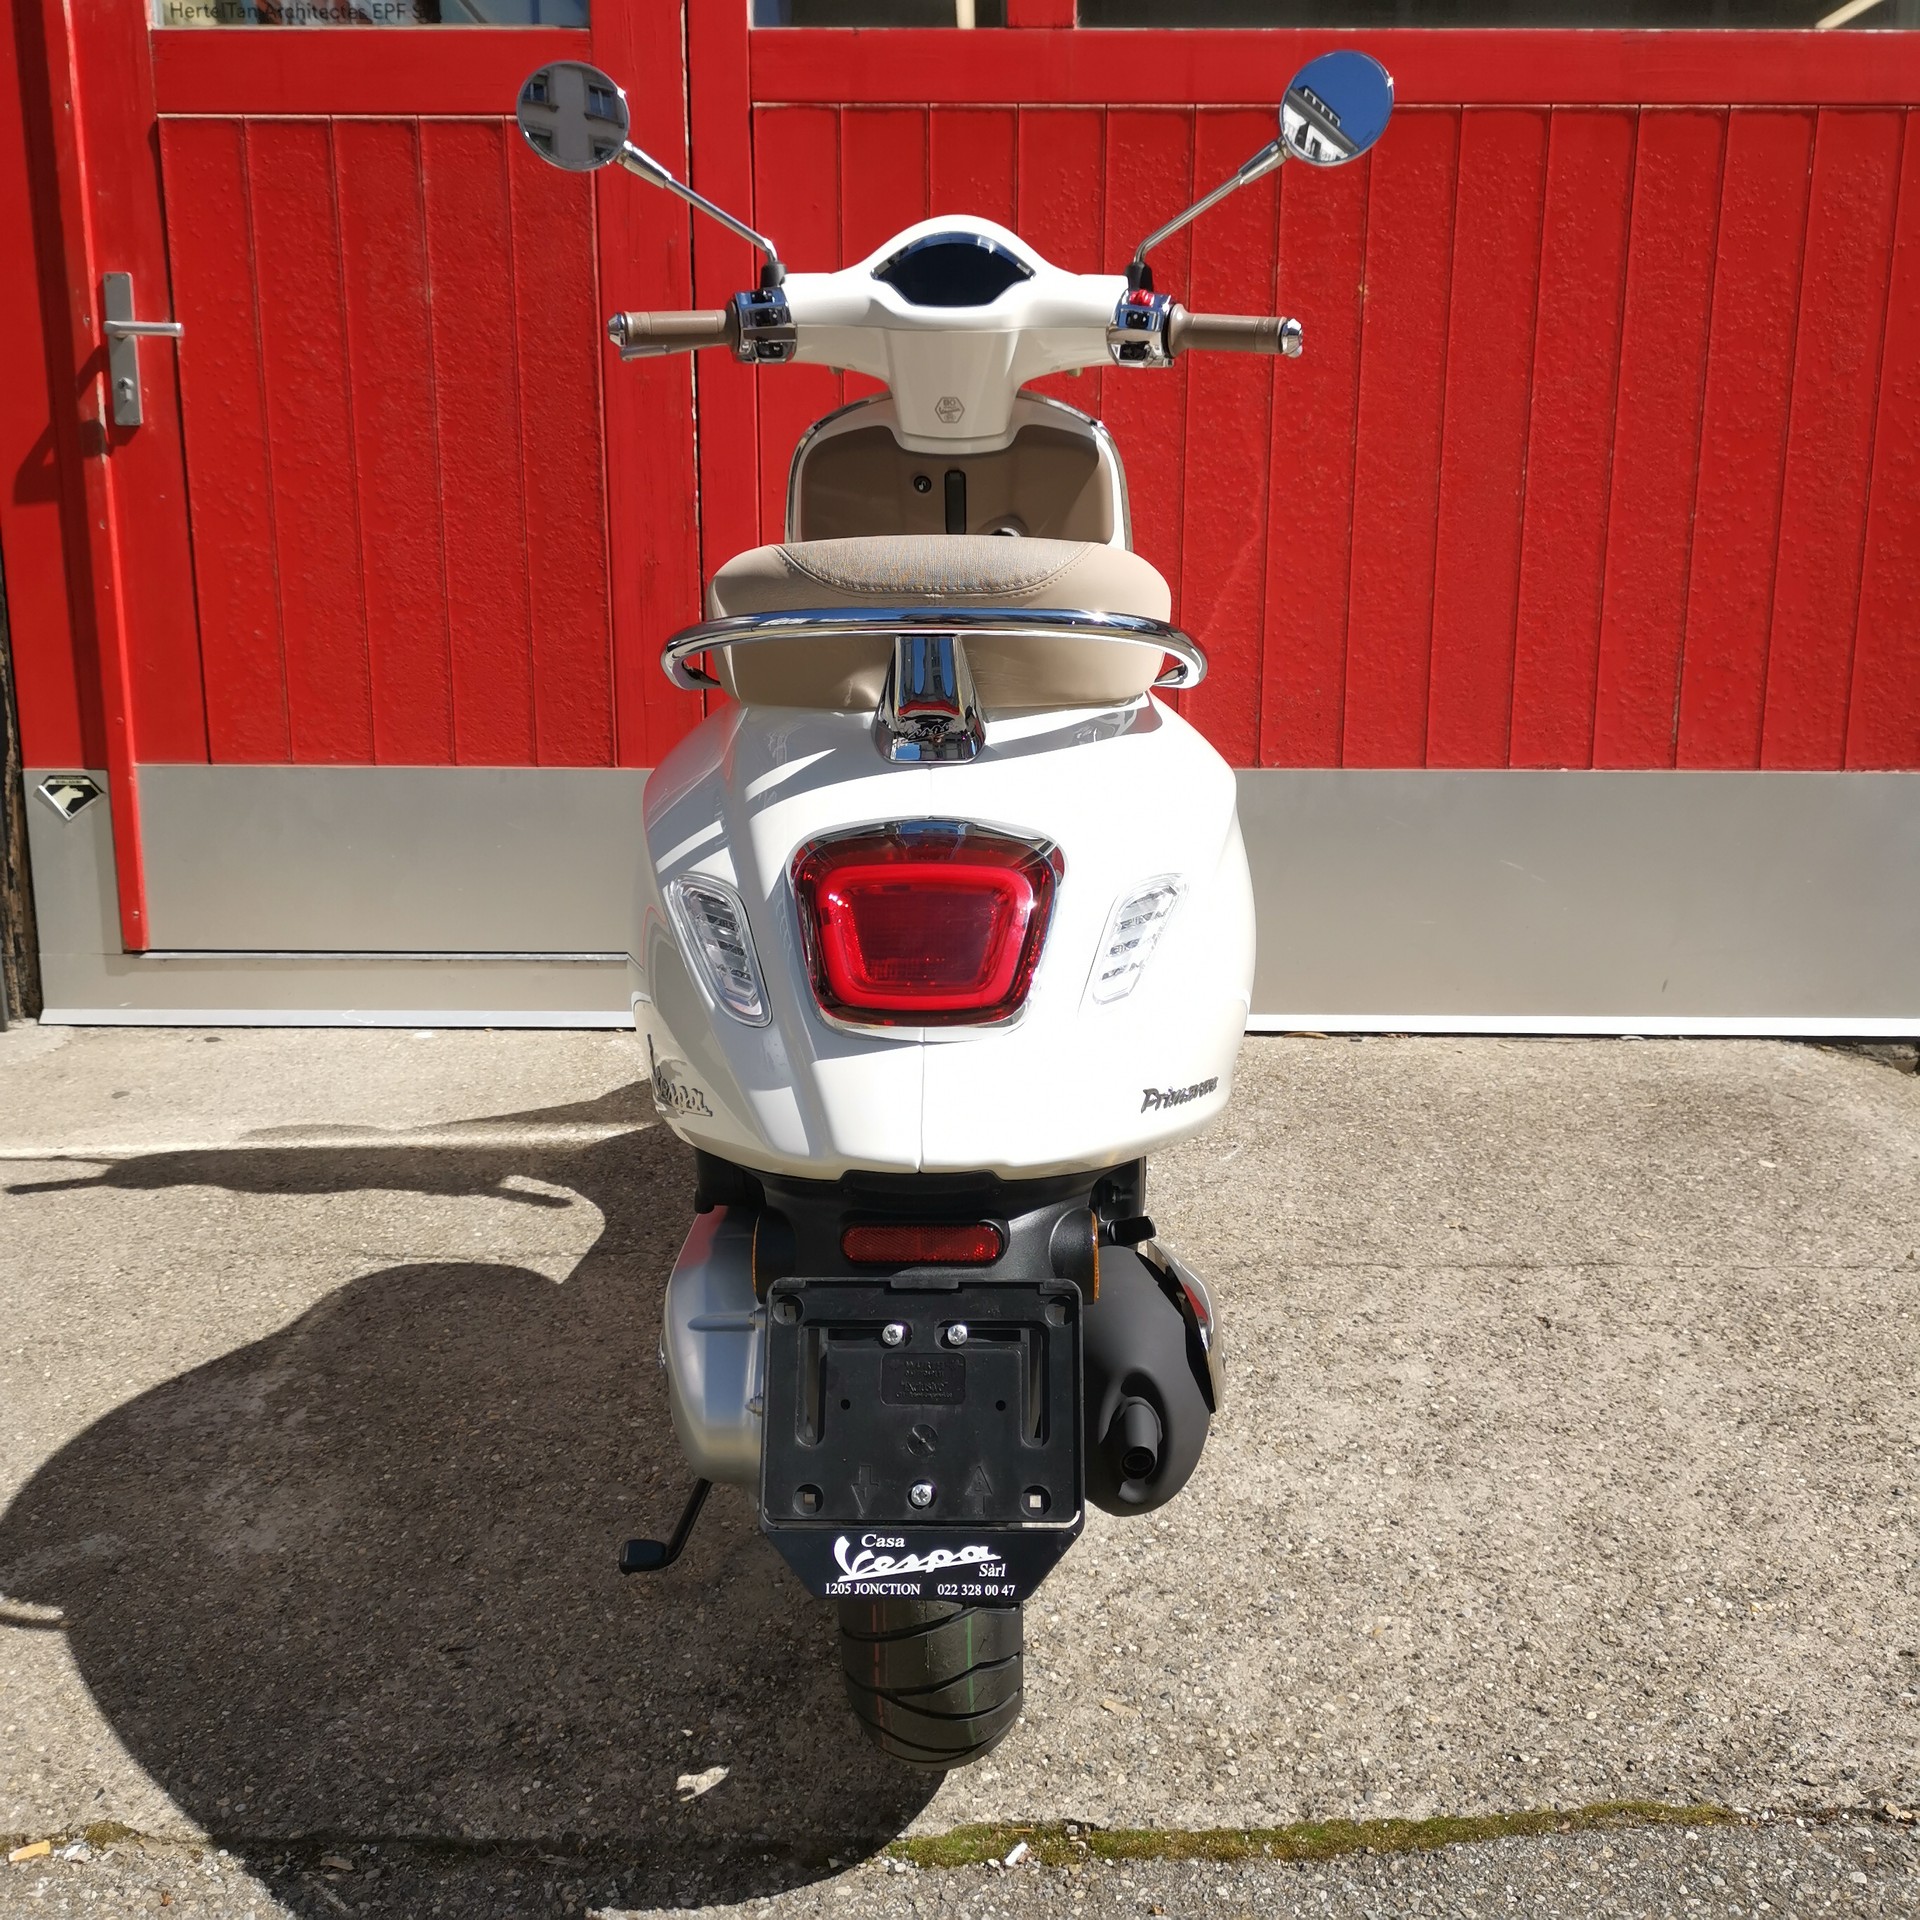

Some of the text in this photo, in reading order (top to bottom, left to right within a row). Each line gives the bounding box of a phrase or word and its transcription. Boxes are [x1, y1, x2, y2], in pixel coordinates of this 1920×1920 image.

[373, 3, 407, 20] EPF
[861, 1533, 906, 1548] Casa
[833, 1535, 1002, 1583] Vespa
[978, 1562, 1006, 1577] Sàrl
[825, 1582, 1016, 1596] 1205 JONCTION 022 328 00 47
